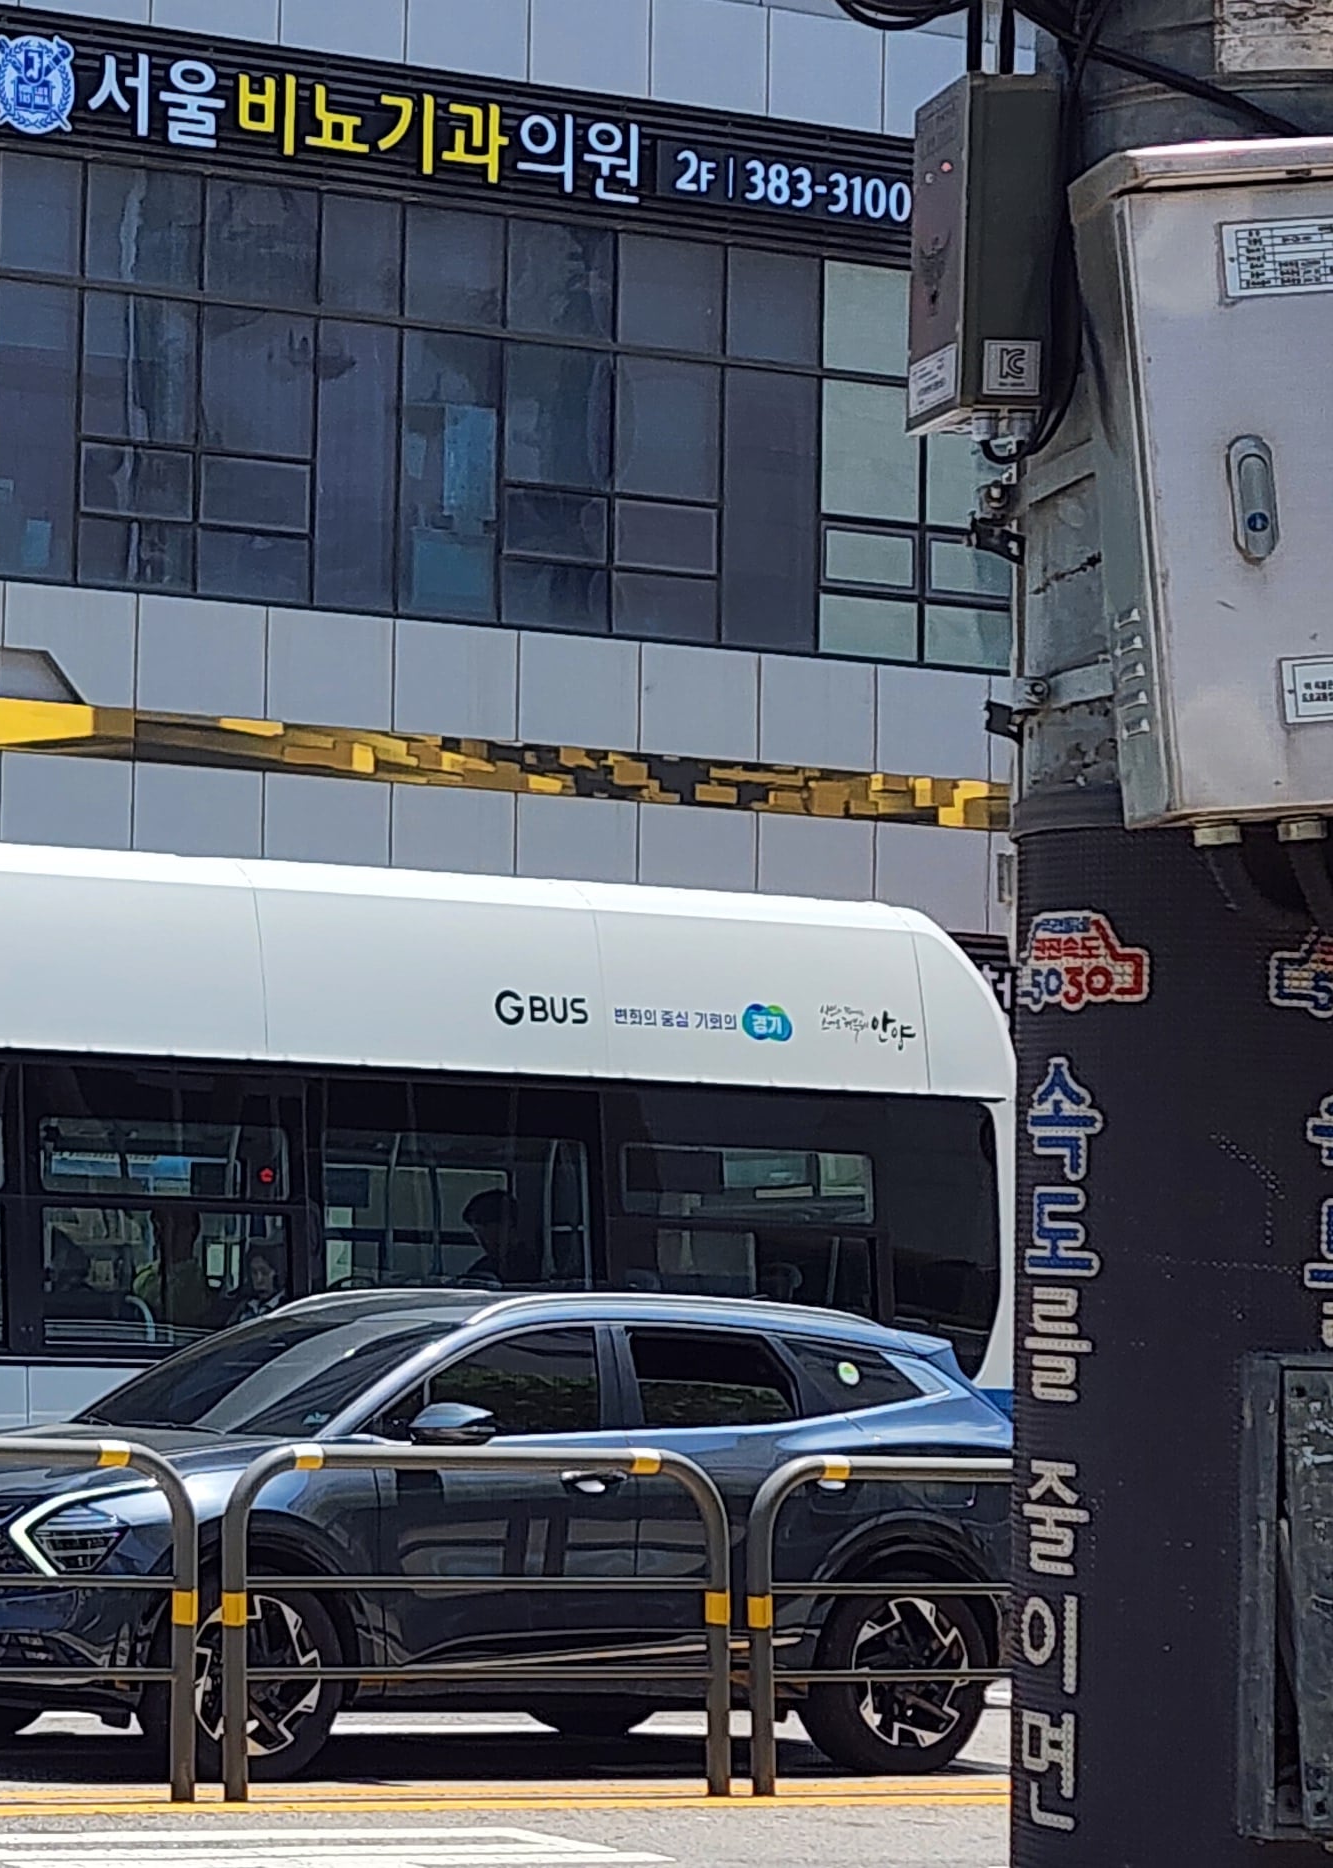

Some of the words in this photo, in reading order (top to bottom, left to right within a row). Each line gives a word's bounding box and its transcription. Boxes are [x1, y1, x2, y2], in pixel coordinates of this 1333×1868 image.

[87, 51, 643, 204] 서울비뇨기과의원
[673, 148, 716, 192] 2F
[745, 158, 911, 223] 383-3100
[614, 1007, 657, 1026] 변화의
[661, 1010, 689, 1028] 중심
[694, 1012, 737, 1030] 기회의
[751, 1014, 783, 1035] 경기
[871, 1010, 917, 1051] 안양
